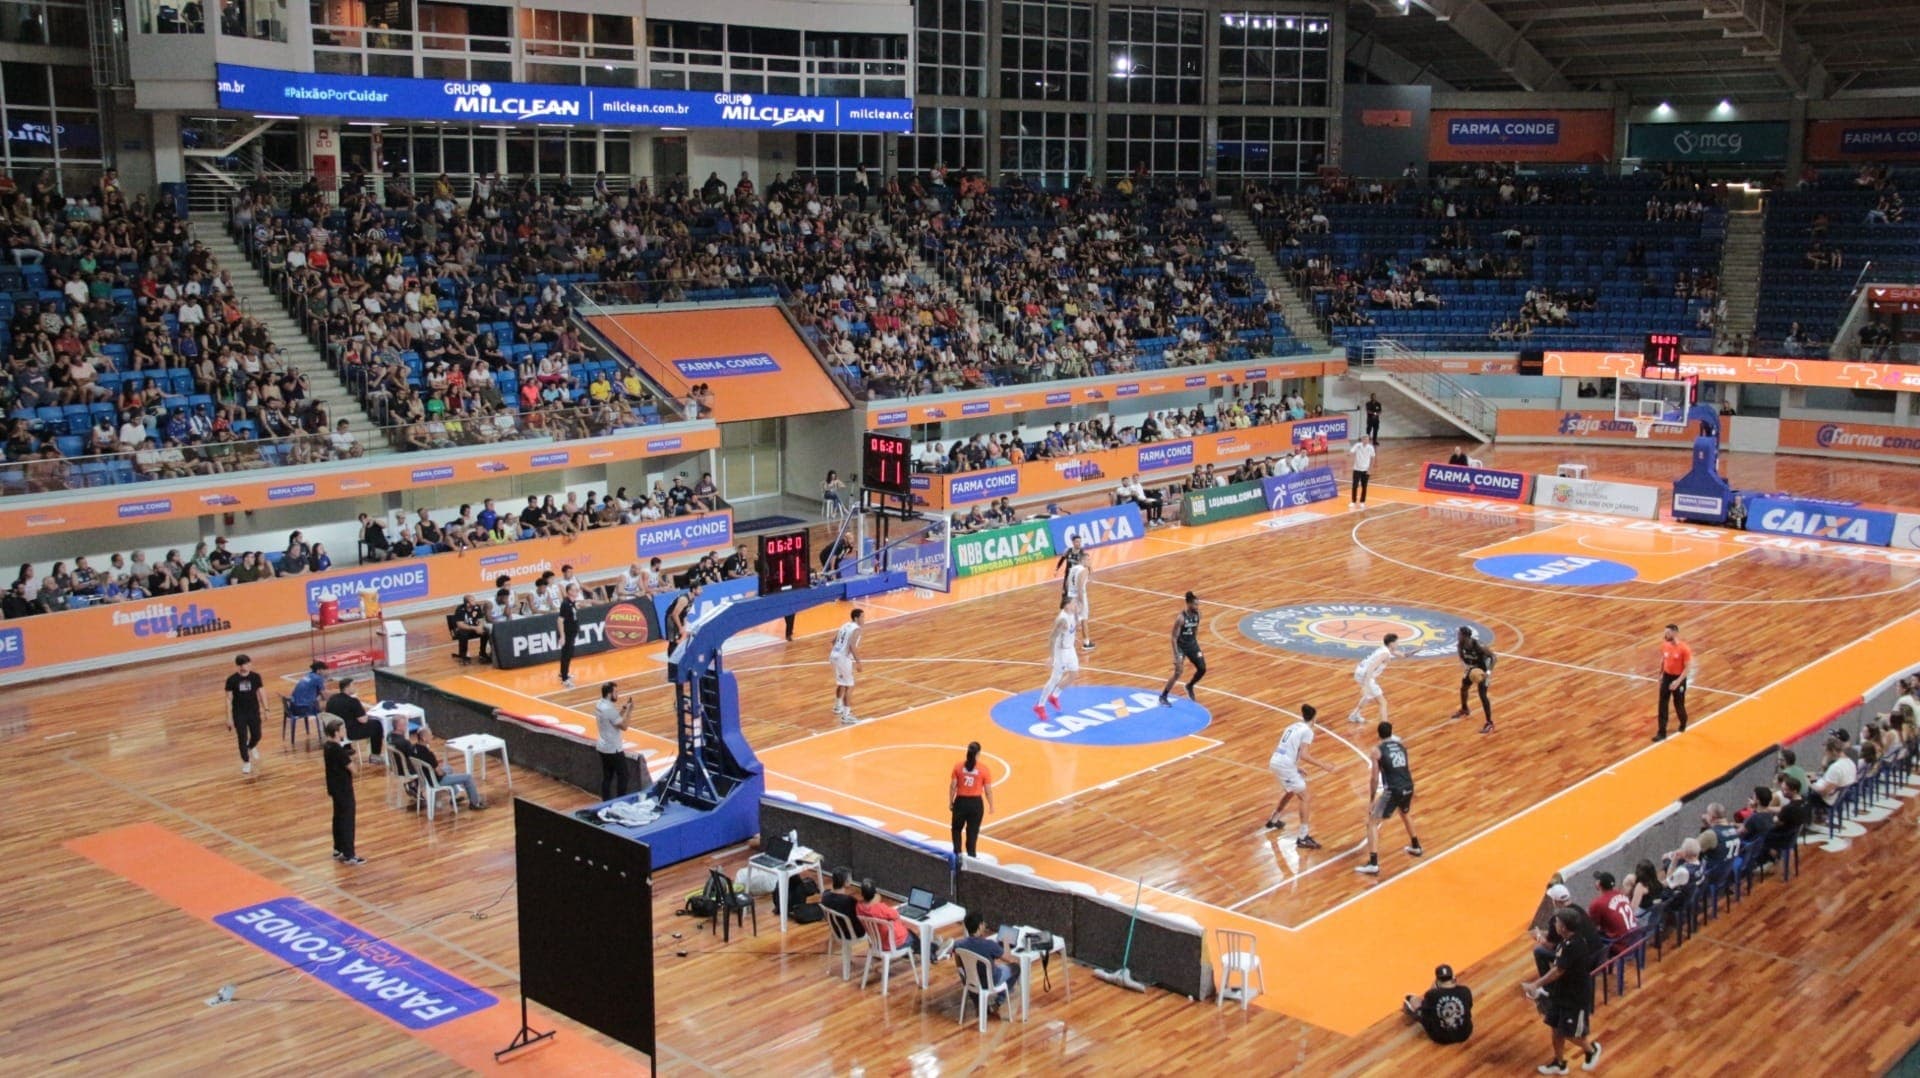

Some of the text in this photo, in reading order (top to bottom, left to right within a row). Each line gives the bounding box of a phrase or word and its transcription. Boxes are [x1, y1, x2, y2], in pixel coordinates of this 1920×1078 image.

[284, 87, 389, 102] #PaixãoPorCuidar
[444, 82, 492, 97] GRUPO
[454, 96, 580, 118] MILCLEAN
[603, 101, 689, 115] milclean.com.br
[714, 93, 752, 106] GRUPO
[722, 106, 825, 123] MILCLEAN
[1451, 123, 1556, 135] FARMA CONDE
[1844, 132, 1894, 144] FARMA
[1700, 133, 1742, 153] mcg
[678, 361, 727, 372] FARMA
[726, 356, 773, 369] CONDE
[871, 438, 903, 454] 06:20
[1140, 444, 1192, 461] FARMA CONDE
[910, 478, 929, 488] ONDE
[952, 474, 1017, 496] FARMA CONDE
[1428, 468, 1519, 489] FARMA CONDE
[639, 520, 727, 546] FARMA CONDE
[1063, 515, 1134, 548] CAIXA
[1761, 508, 1868, 542] CAIXA
[768, 536, 802, 554] 06:20
[983, 527, 1050, 562] CAIXA
[969, 559, 1014, 576] TEMPORADA
[1513, 556, 1603, 582] CAIXA
[311, 569, 425, 602] FARMA CONDE
[134, 603, 217, 637] cuida
[175, 617, 232, 638] família
[609, 613, 641, 623] PENALTY
[1028, 691, 1178, 739] CAIXA
[234, 907, 459, 1022] FARMA CONDE
